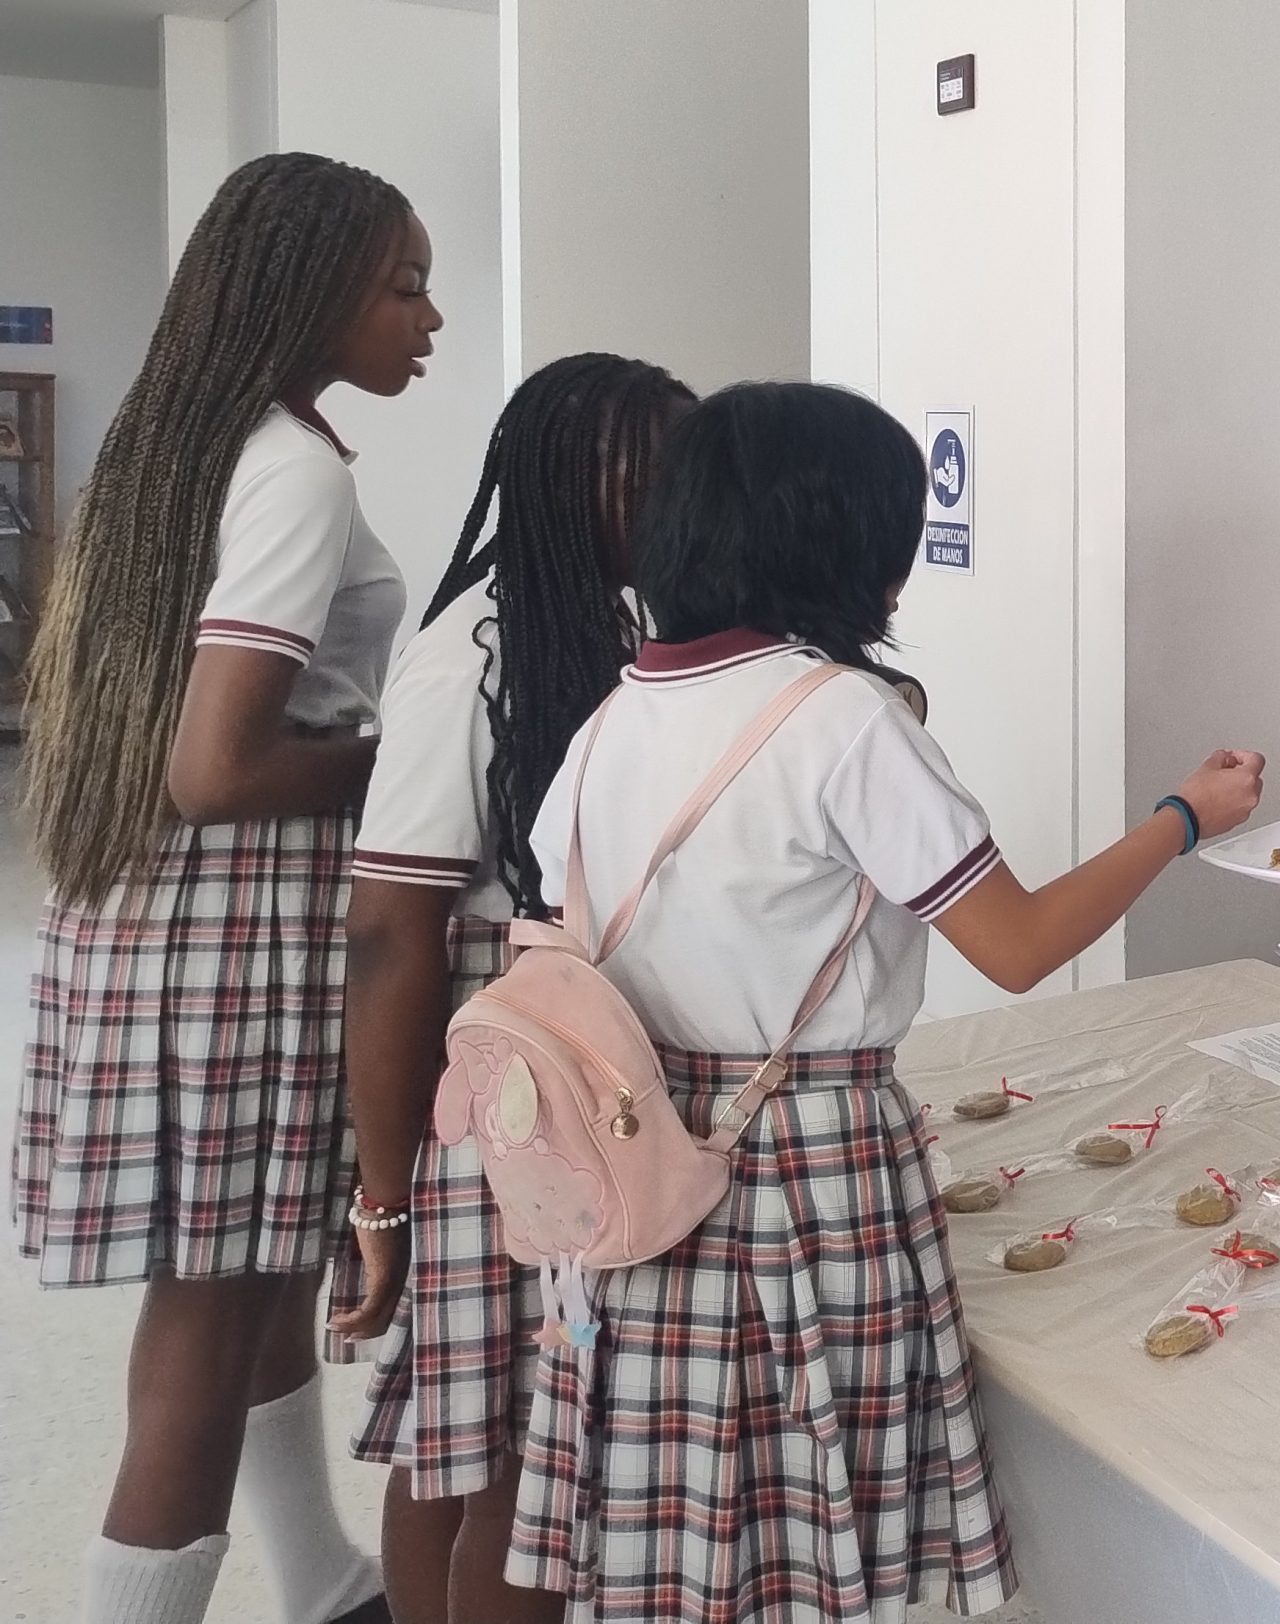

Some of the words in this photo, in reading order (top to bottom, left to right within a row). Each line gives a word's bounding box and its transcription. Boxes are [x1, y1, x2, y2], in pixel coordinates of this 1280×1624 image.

[928, 526, 968, 545] DESINFECCIÓN
[933, 546, 941, 561] DE
[942, 547, 963, 564] MANOS
